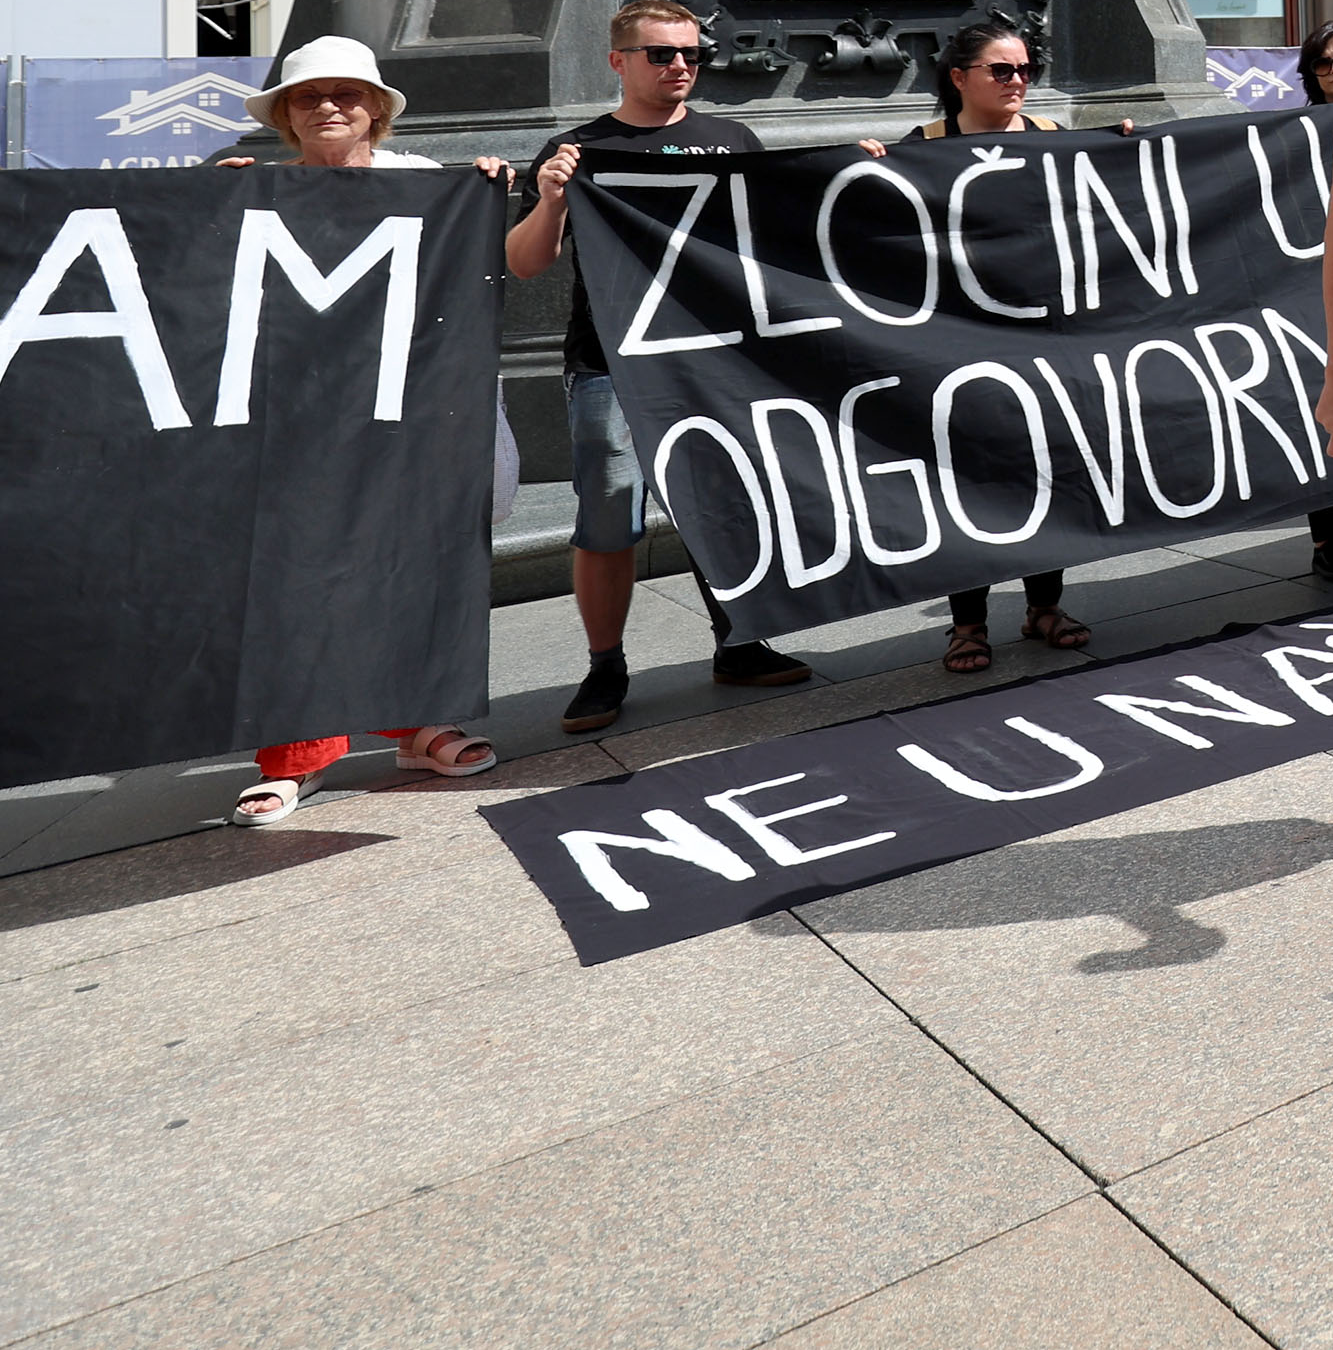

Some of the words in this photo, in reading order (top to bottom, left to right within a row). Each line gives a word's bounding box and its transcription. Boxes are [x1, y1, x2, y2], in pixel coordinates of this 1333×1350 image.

[0, 207, 424, 431] AM
[592, 134, 1200, 357] ZLOČINI
[557, 772, 897, 913] NE
[896, 715, 1104, 802] U
